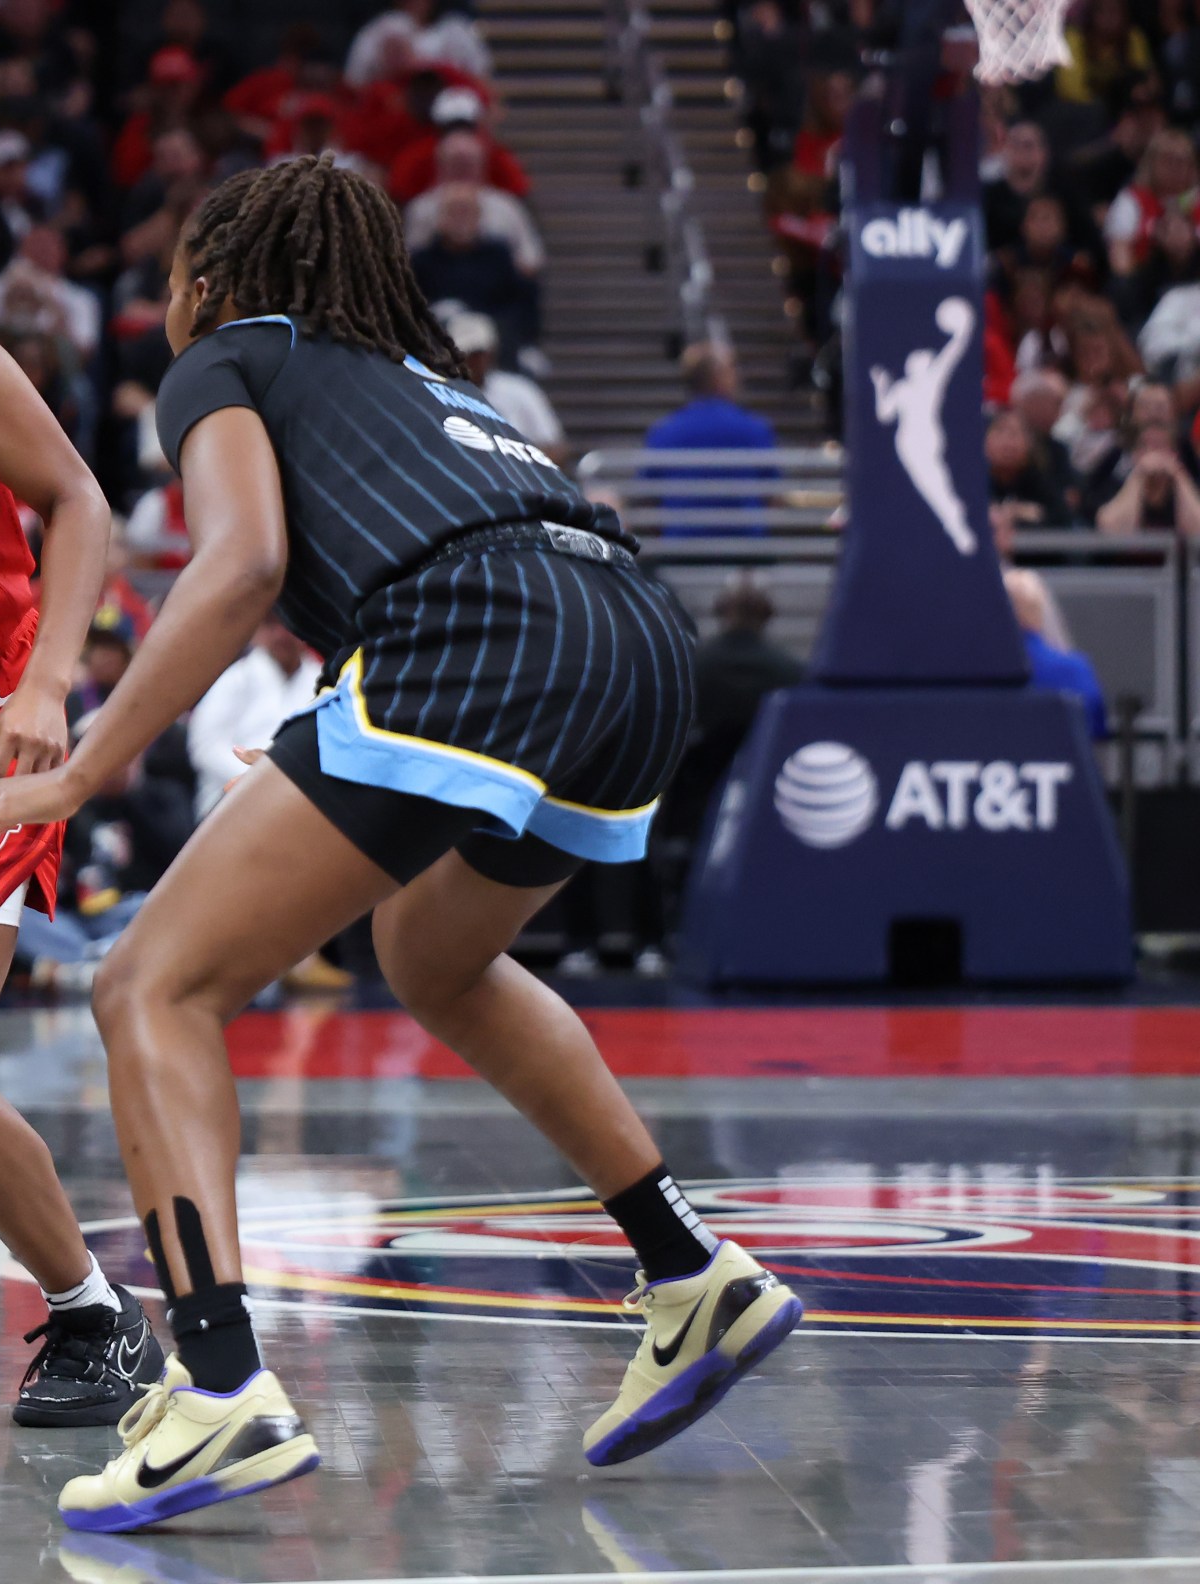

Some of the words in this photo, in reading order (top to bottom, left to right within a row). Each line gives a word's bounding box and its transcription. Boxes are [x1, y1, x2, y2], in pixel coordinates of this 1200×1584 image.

[860, 206, 967, 269] ally
[493, 434, 560, 470] AT&
[885, 760, 1074, 832] AT&T
